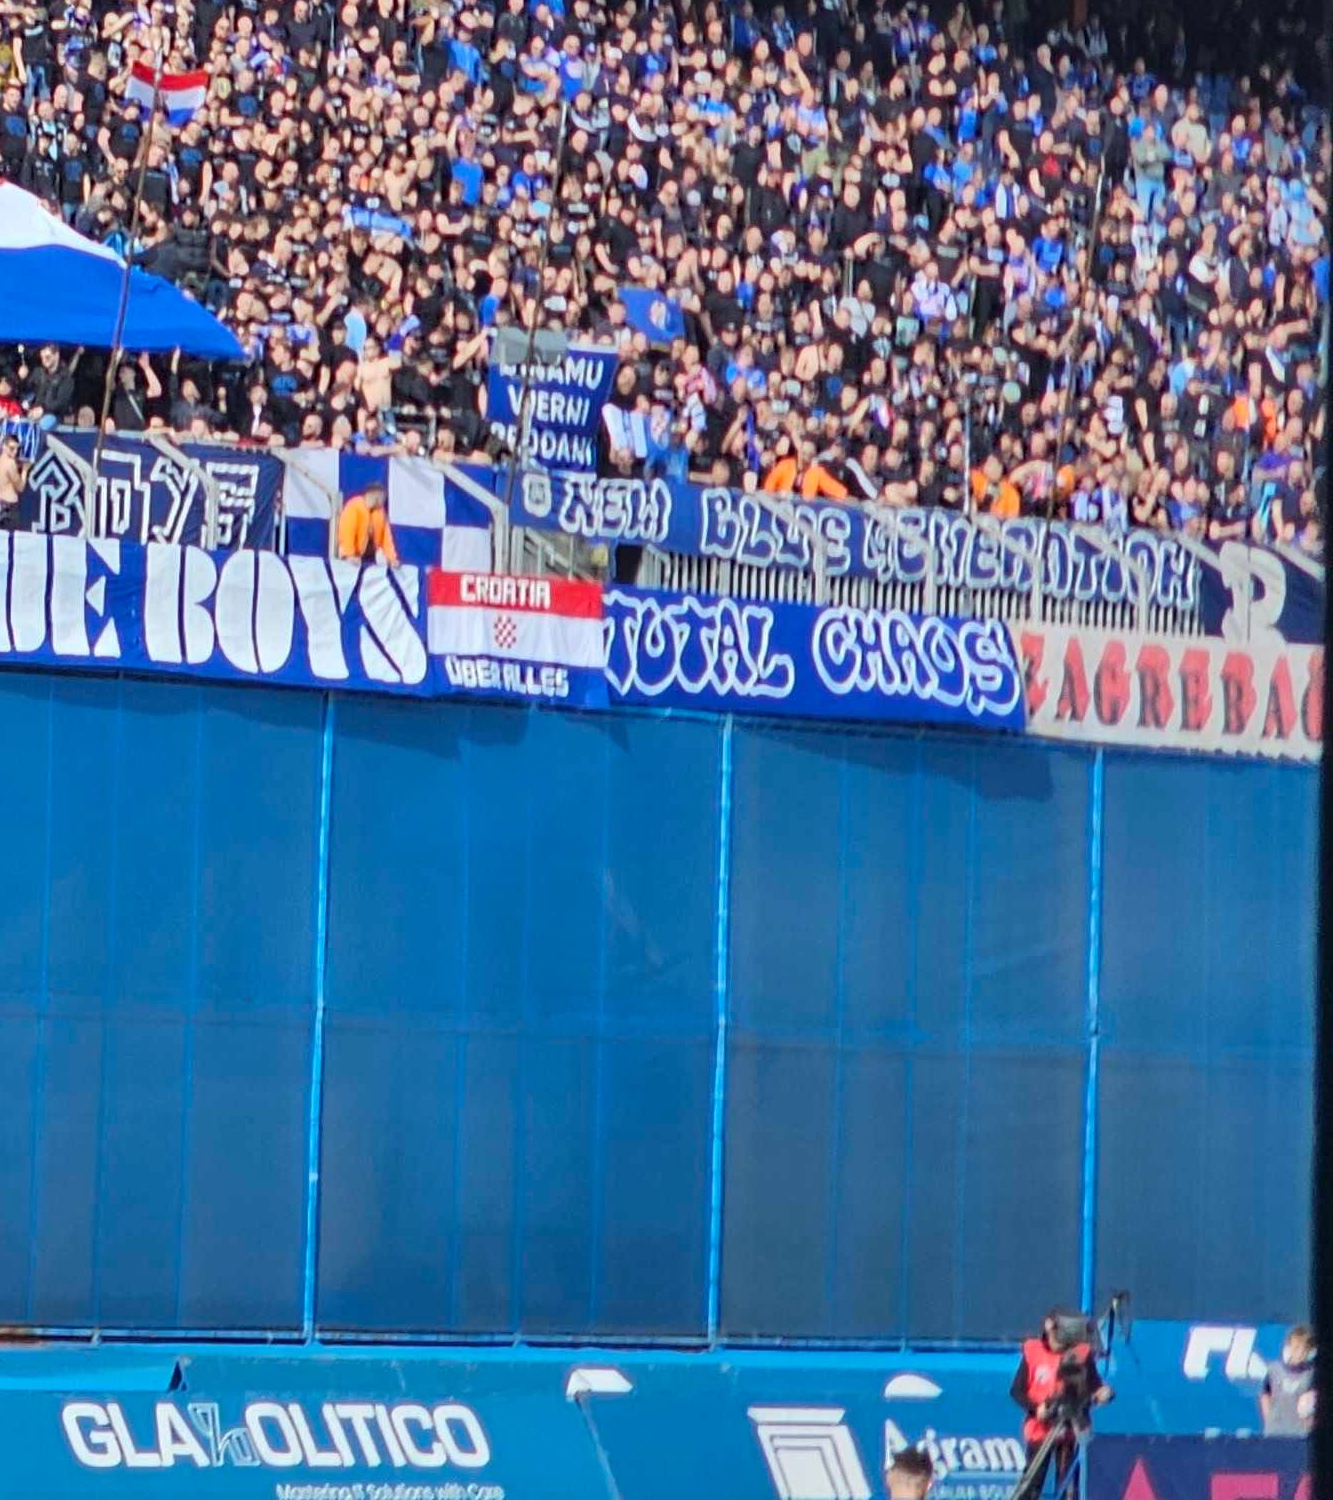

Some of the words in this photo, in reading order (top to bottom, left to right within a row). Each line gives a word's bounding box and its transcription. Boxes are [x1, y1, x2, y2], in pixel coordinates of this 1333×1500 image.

[507, 384, 591, 427] VJERNI
[460, 573, 551, 610] CROATIA
[142, 543, 427, 685] BOYS
[502, 662, 570, 698] ALLES
[811, 604, 1022, 717] CHAOS
